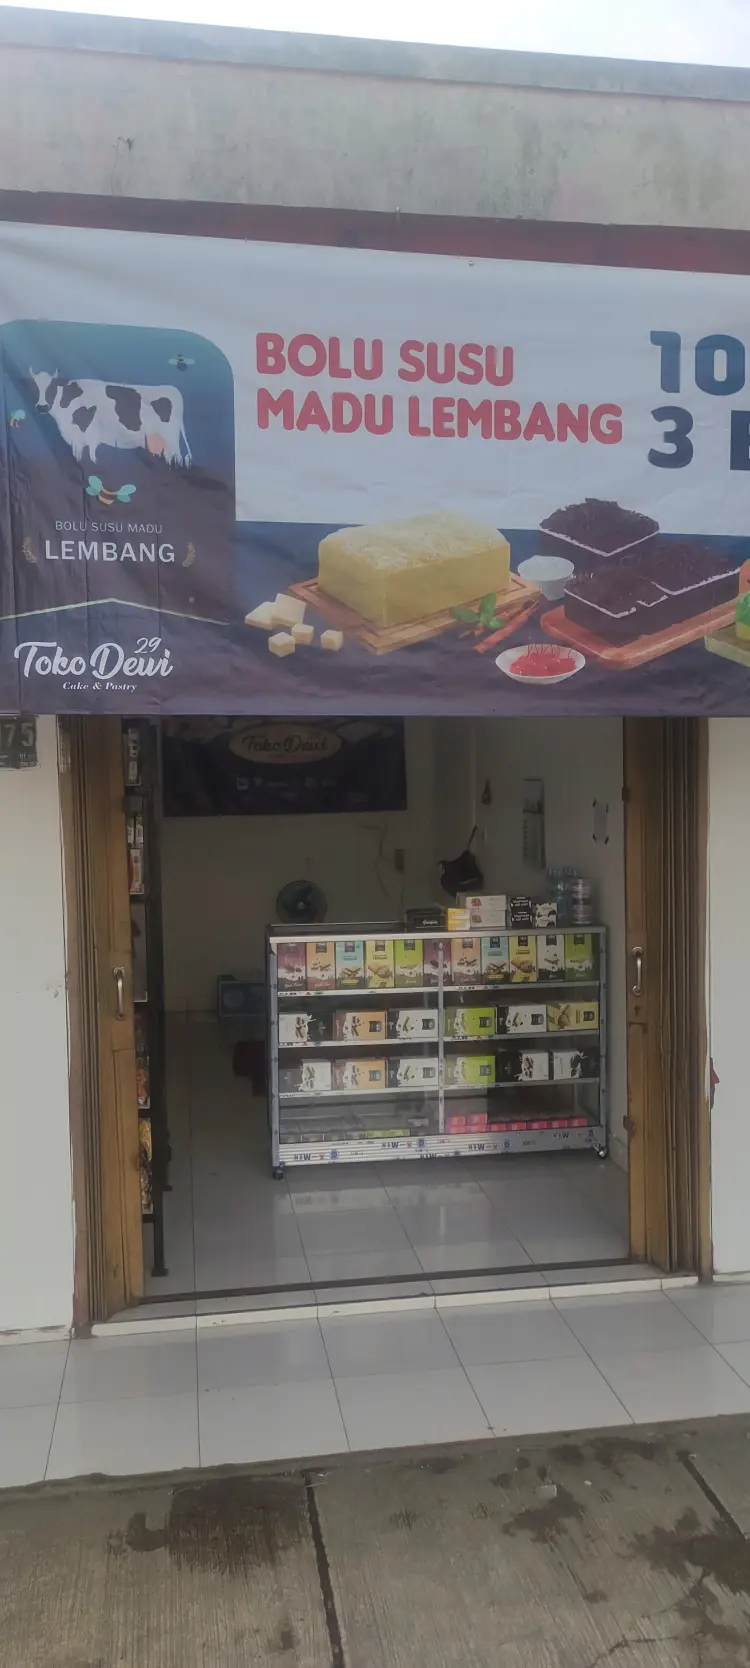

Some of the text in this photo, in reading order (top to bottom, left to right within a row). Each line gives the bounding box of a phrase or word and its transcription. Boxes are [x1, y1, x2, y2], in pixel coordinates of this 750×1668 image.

[256, 332, 515, 387] BOLU SUSU
[649, 330, 746, 396] 10
[256, 388, 623, 445] MADU LEMBANG
[648, 405, 694, 469] 3
[55, 520, 163, 535] BOLU SUSU MADU
[45, 539, 175, 563] LEMBANG
[134, 637, 161, 655] 29
[14, 641, 174, 681] Toko Dewi
[62, 681, 137, 693] Cake & Pastry
[0, 722, 34, 747] 75
[241, 735, 280, 754] Toko
